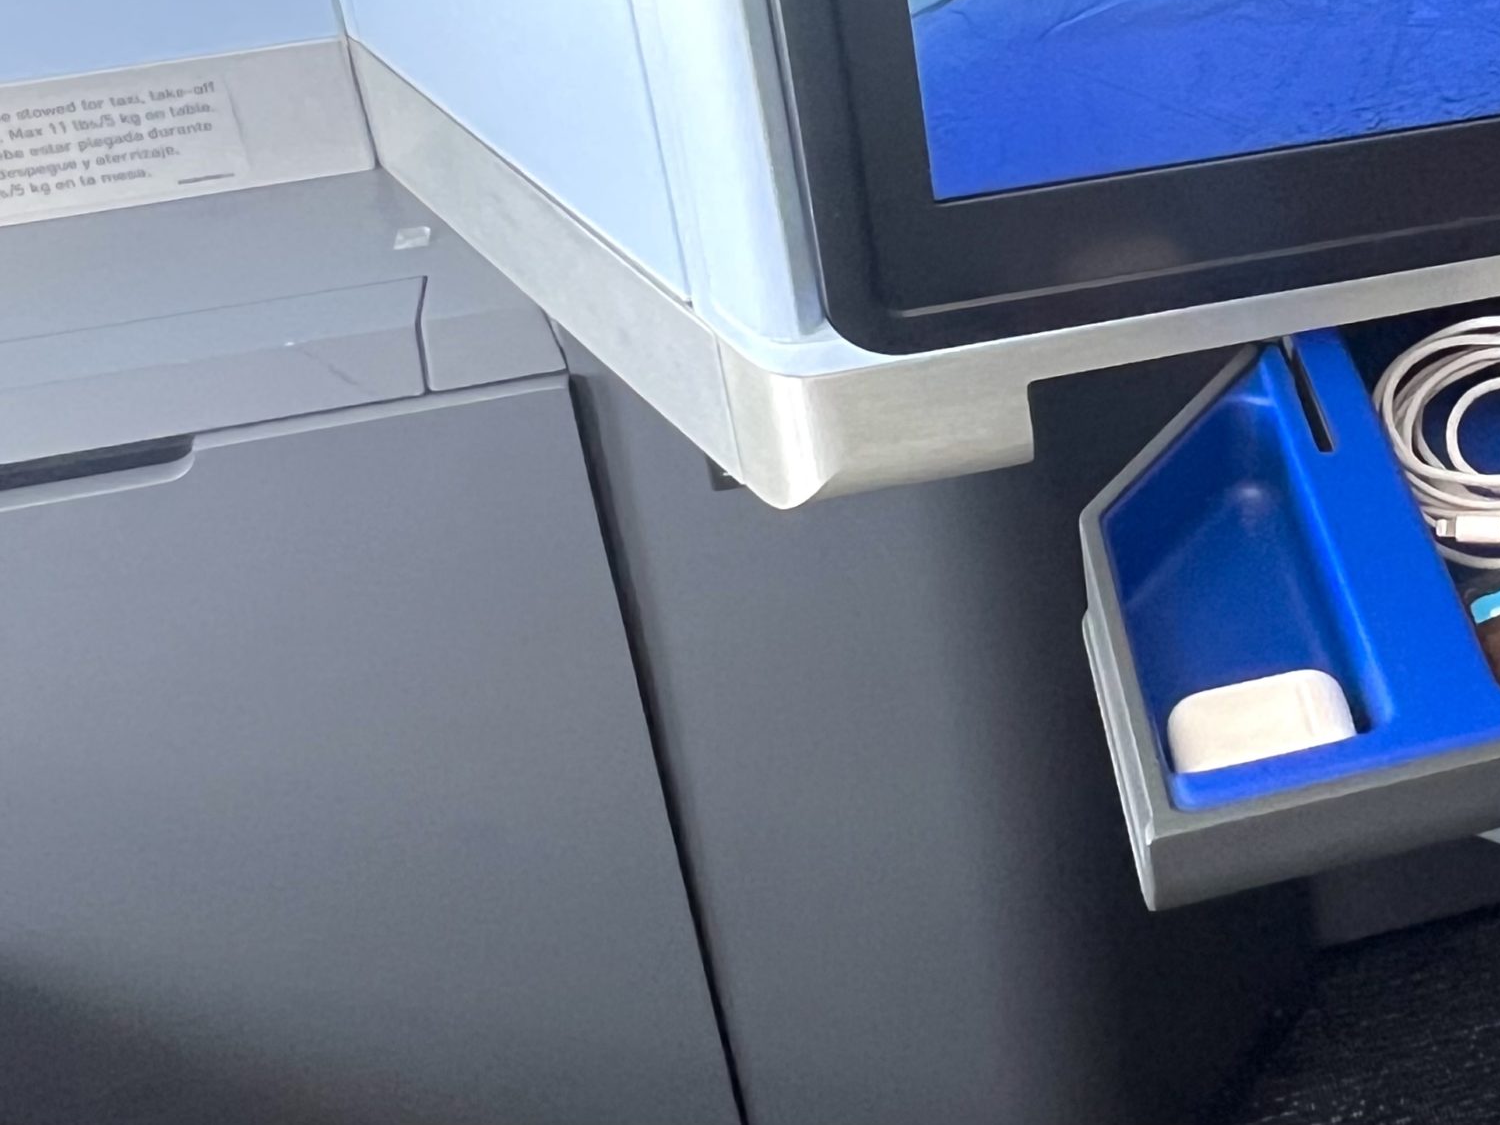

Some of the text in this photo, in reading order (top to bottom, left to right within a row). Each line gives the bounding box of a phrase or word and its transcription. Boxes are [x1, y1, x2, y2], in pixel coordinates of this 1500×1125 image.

[16, 101, 77, 121] stowed
[81, 98, 104, 111] for
[148, 80, 216, 101] take-off
[8, 127, 43, 141] Max
[48, 120, 67, 135] 11
[119, 113, 142, 127] kg
[145, 110, 166, 121] on
[148, 122, 213, 140] durante
[82, 159, 91, 171] y
[29, 181, 52, 196] kg
[79, 174, 97, 187] la
